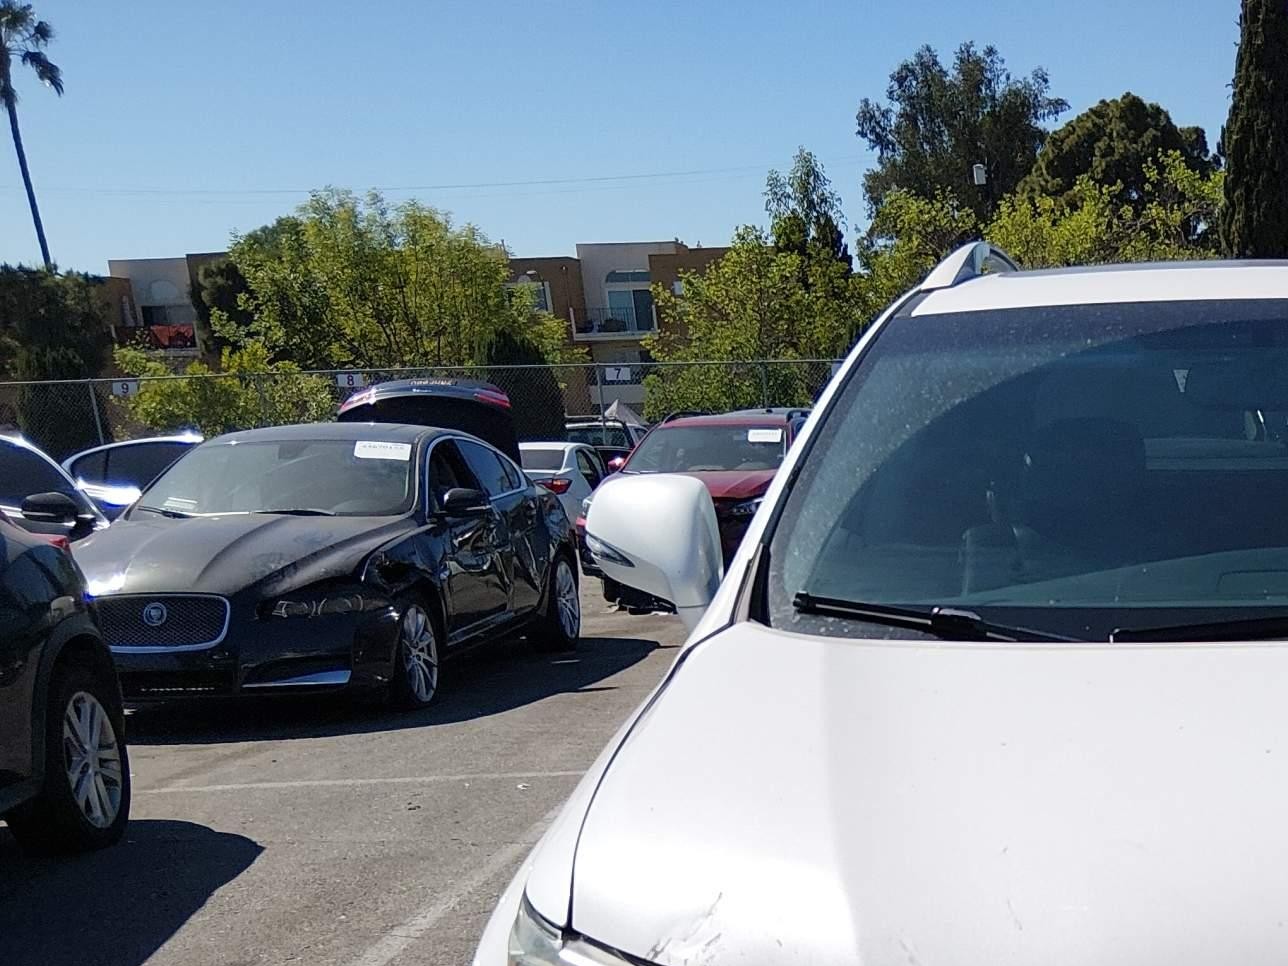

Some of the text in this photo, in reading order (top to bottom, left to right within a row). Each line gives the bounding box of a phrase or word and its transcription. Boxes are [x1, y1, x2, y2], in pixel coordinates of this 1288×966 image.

[614, 367, 622, 380] 7
[347, 375, 355, 386] 8
[121, 382, 129, 394] 9
